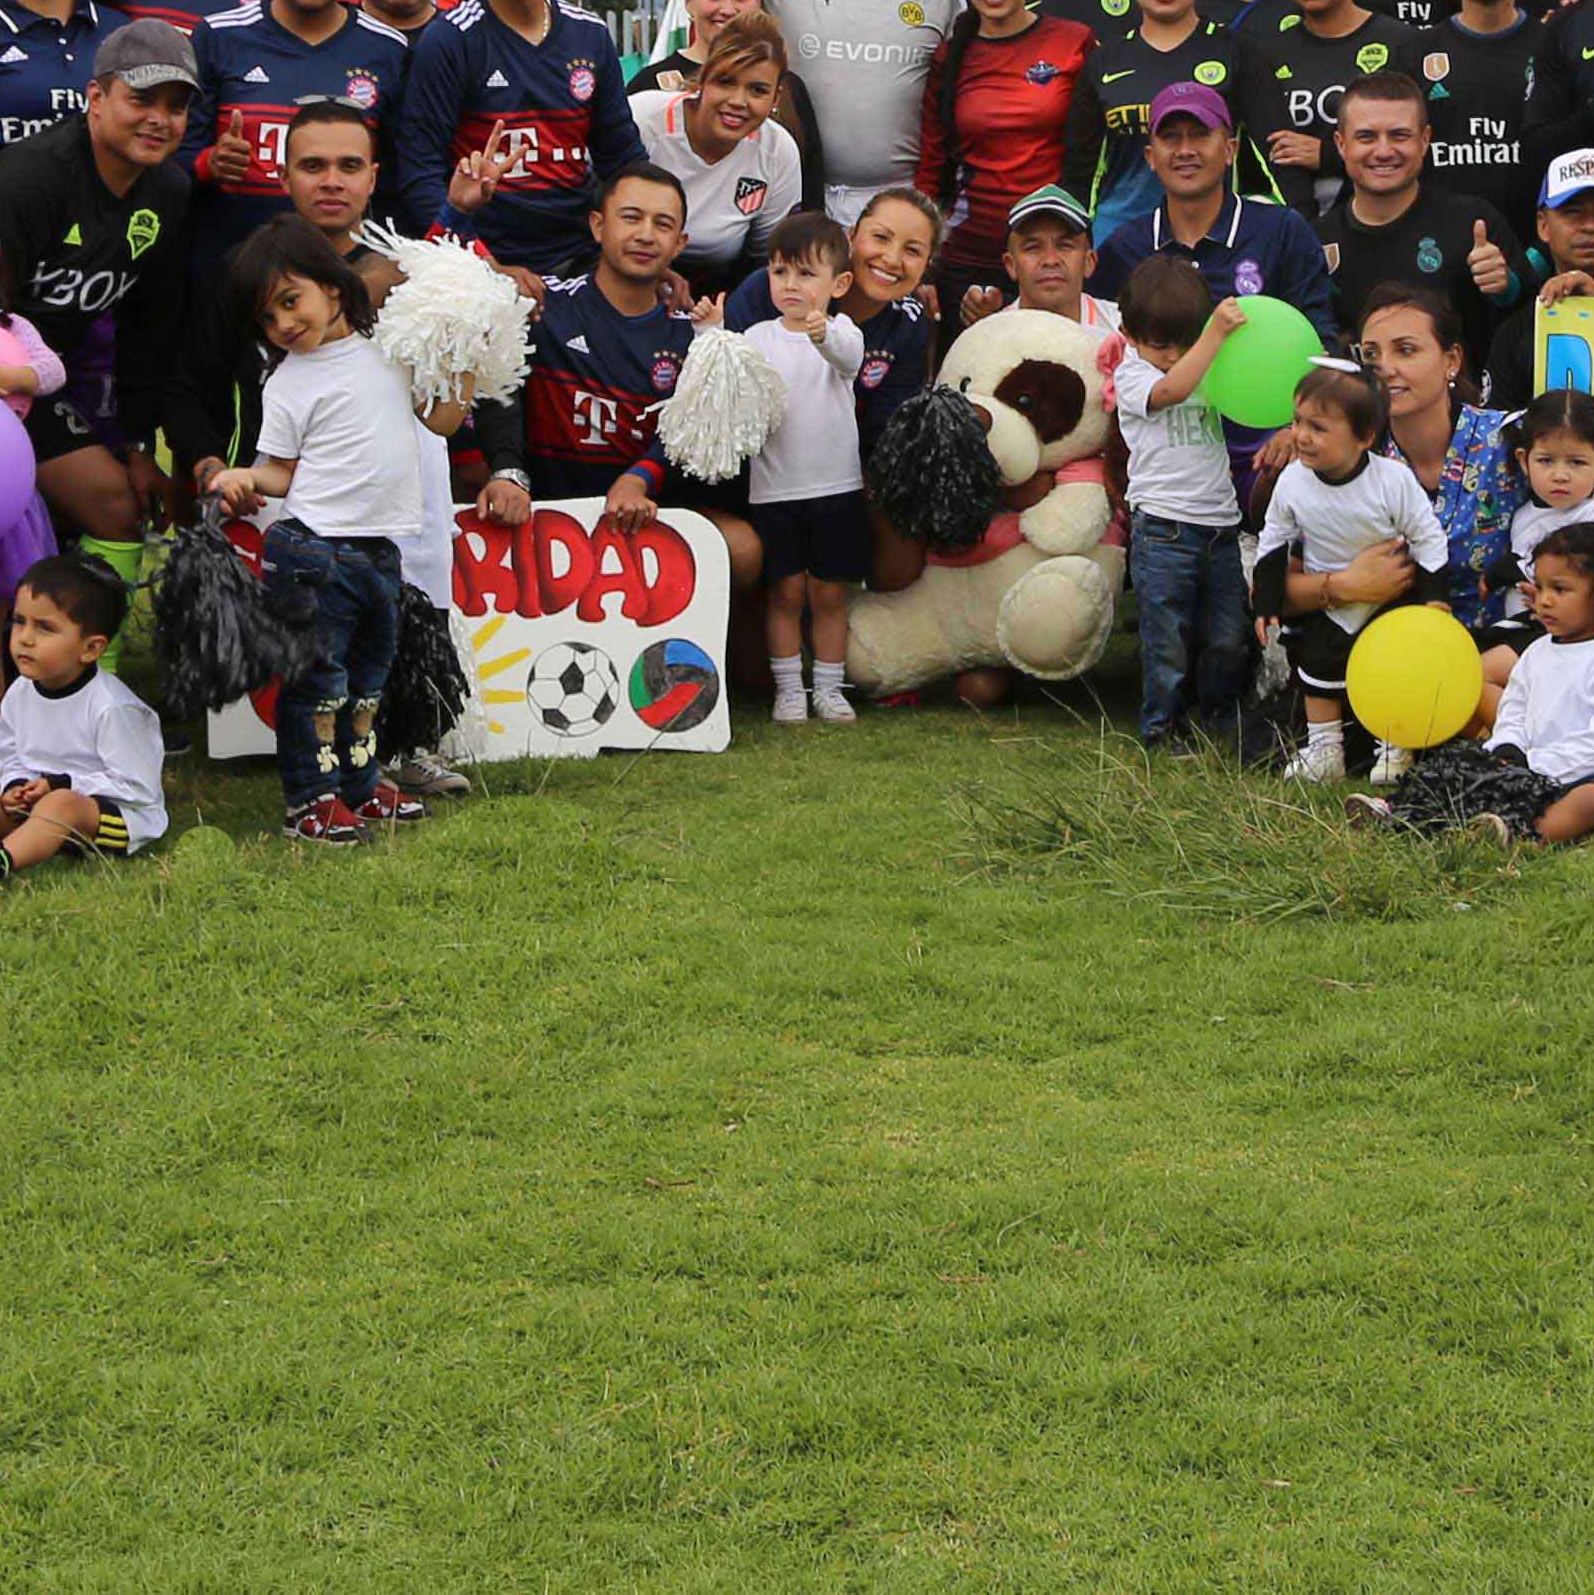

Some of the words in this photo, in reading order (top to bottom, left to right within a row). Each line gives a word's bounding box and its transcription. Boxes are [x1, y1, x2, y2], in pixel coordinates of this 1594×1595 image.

[1396, 1, 1432, 21] Fly
[1469, 117, 1506, 139] Fly
[1430, 138, 1522, 167] Emirat
[452, 506, 697, 628] RIDAD
